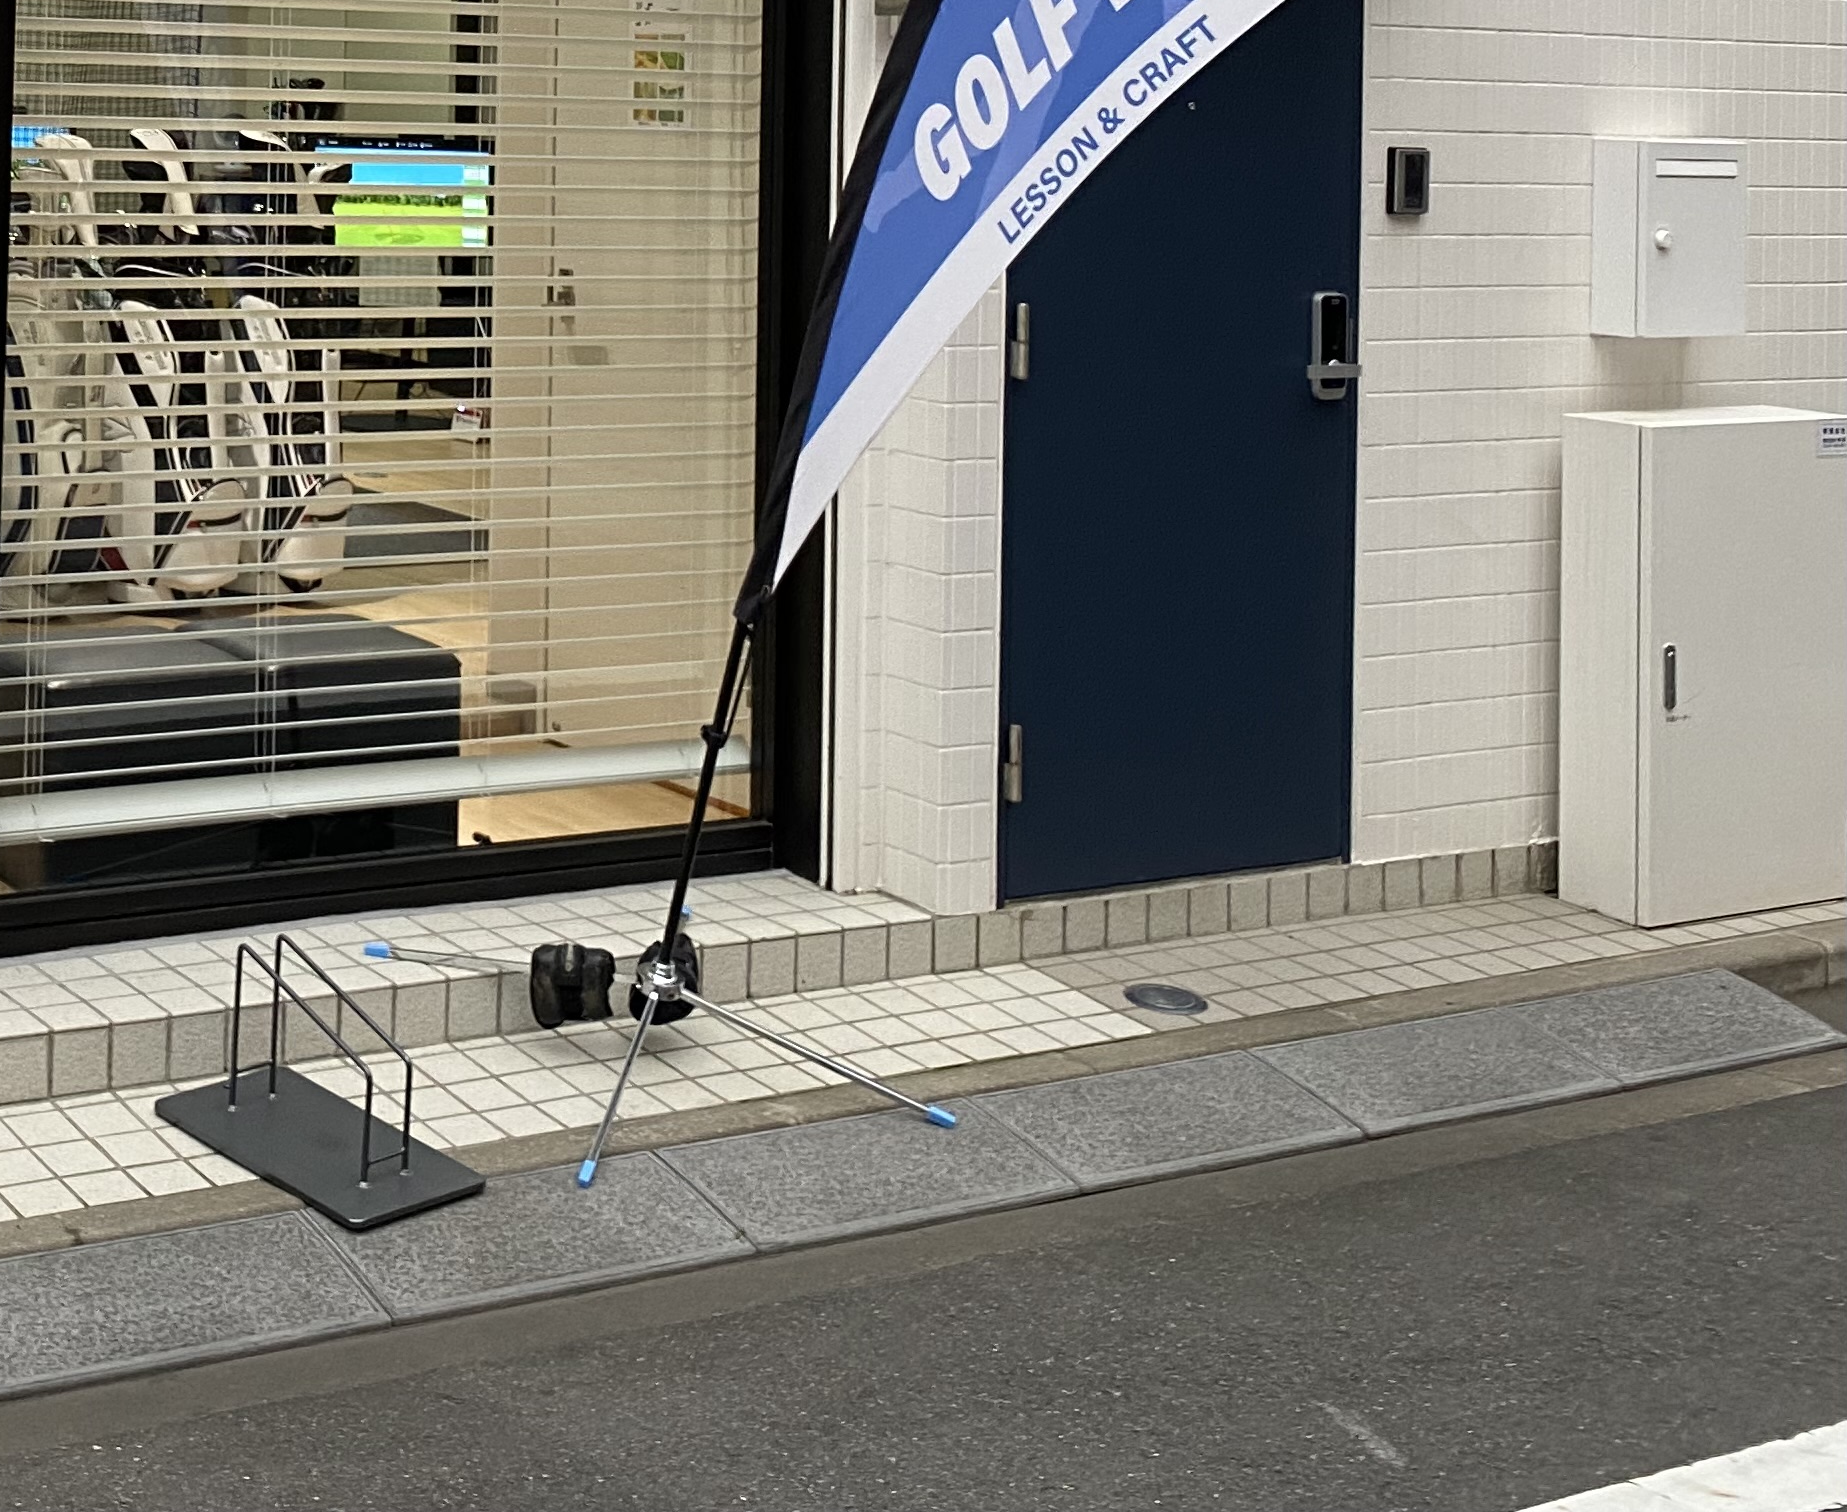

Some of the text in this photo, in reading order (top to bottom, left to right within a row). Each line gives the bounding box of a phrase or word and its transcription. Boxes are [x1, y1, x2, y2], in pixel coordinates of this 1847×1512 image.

[997, 14, 1219, 245] LESSON & CRAFT
